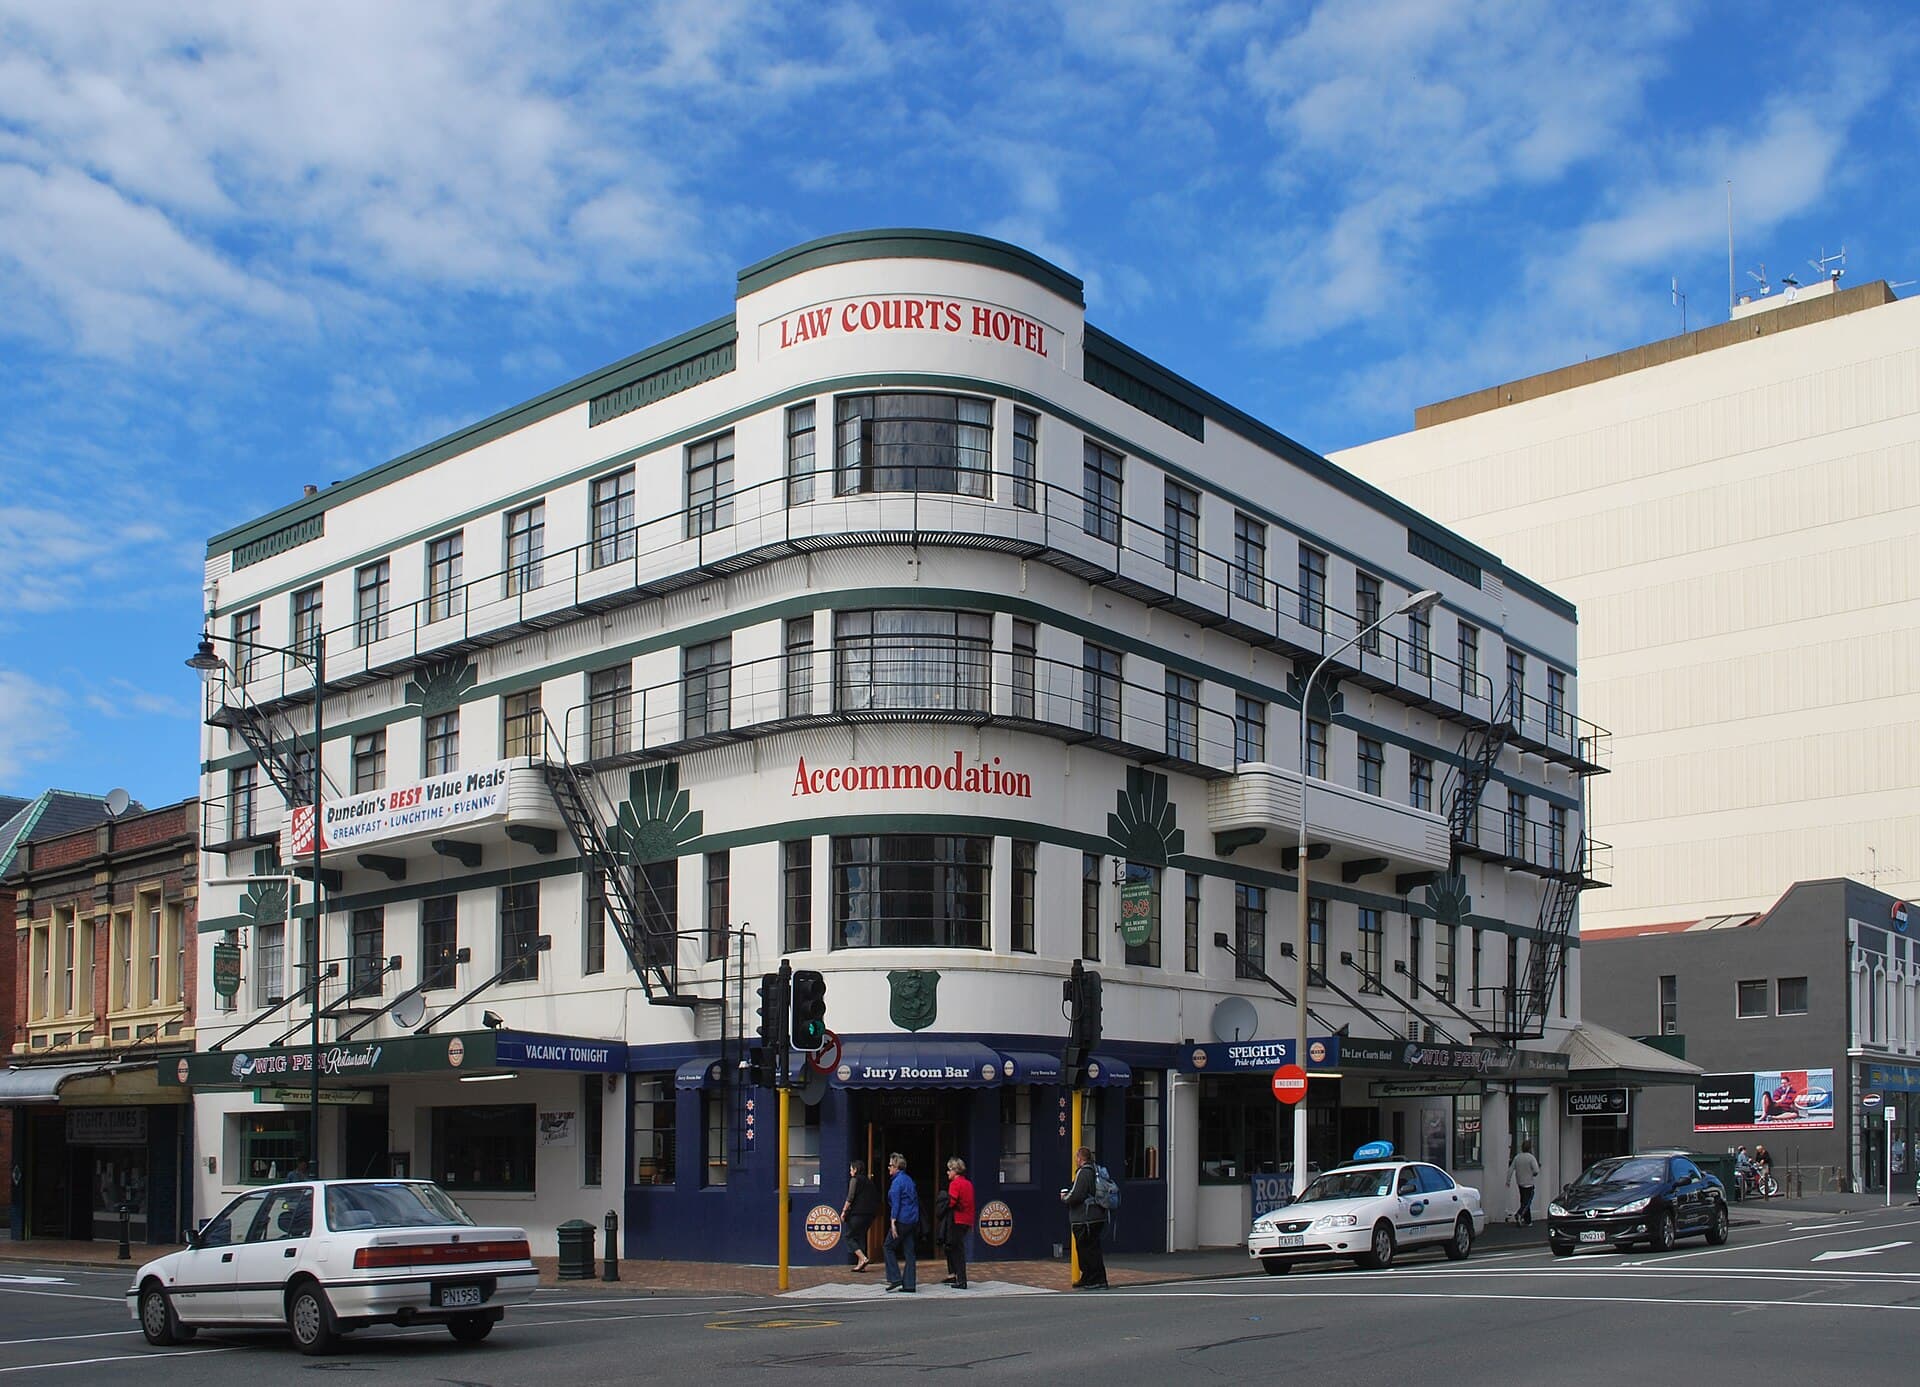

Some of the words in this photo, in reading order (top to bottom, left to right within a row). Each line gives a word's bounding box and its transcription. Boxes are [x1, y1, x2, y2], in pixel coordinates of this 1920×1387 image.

[780, 307, 832, 349] LAW
[842, 300, 961, 332] COURTS
[971, 306, 1047, 358] HOTEL
[792, 751, 1032, 798] Accommodation
[327, 797, 385, 823] Dunedin's
[389, 787, 422, 810] BEST
[427, 781, 462, 801] Value
[466, 768, 505, 792] Meals
[333, 820, 381, 840] BREAKFAST
[390, 806, 443, 828] LUNCHTIME
[454, 794, 496, 814] EVENING
[254, 1055, 288, 1074] WIG
[325, 1043, 374, 1074] Restaurant
[526, 1045, 567, 1061] VACANCY
[569, 1048, 609, 1063] TONIGHT
[1228, 1044, 1286, 1059] SPEIGHT'S
[1421, 1048, 1450, 1067] WIG
[1453, 1050, 1482, 1067] PEN
[1234, 1058, 1250, 1067] Pride
[1250, 1058, 1257, 1068] of
[1256, 1057, 1264, 1065] the
[1265, 1056, 1281, 1065] South
[863, 1067, 897, 1081] Jury
[900, 1067, 942, 1079] Room
[945, 1066, 970, 1079] Bar
[1570, 1095, 1608, 1104] GAMING
[1575, 1102, 1603, 1111] LOUNGE
[1255, 1179, 1294, 1200] ROAS
[442, 1288, 480, 1303] PN1958
